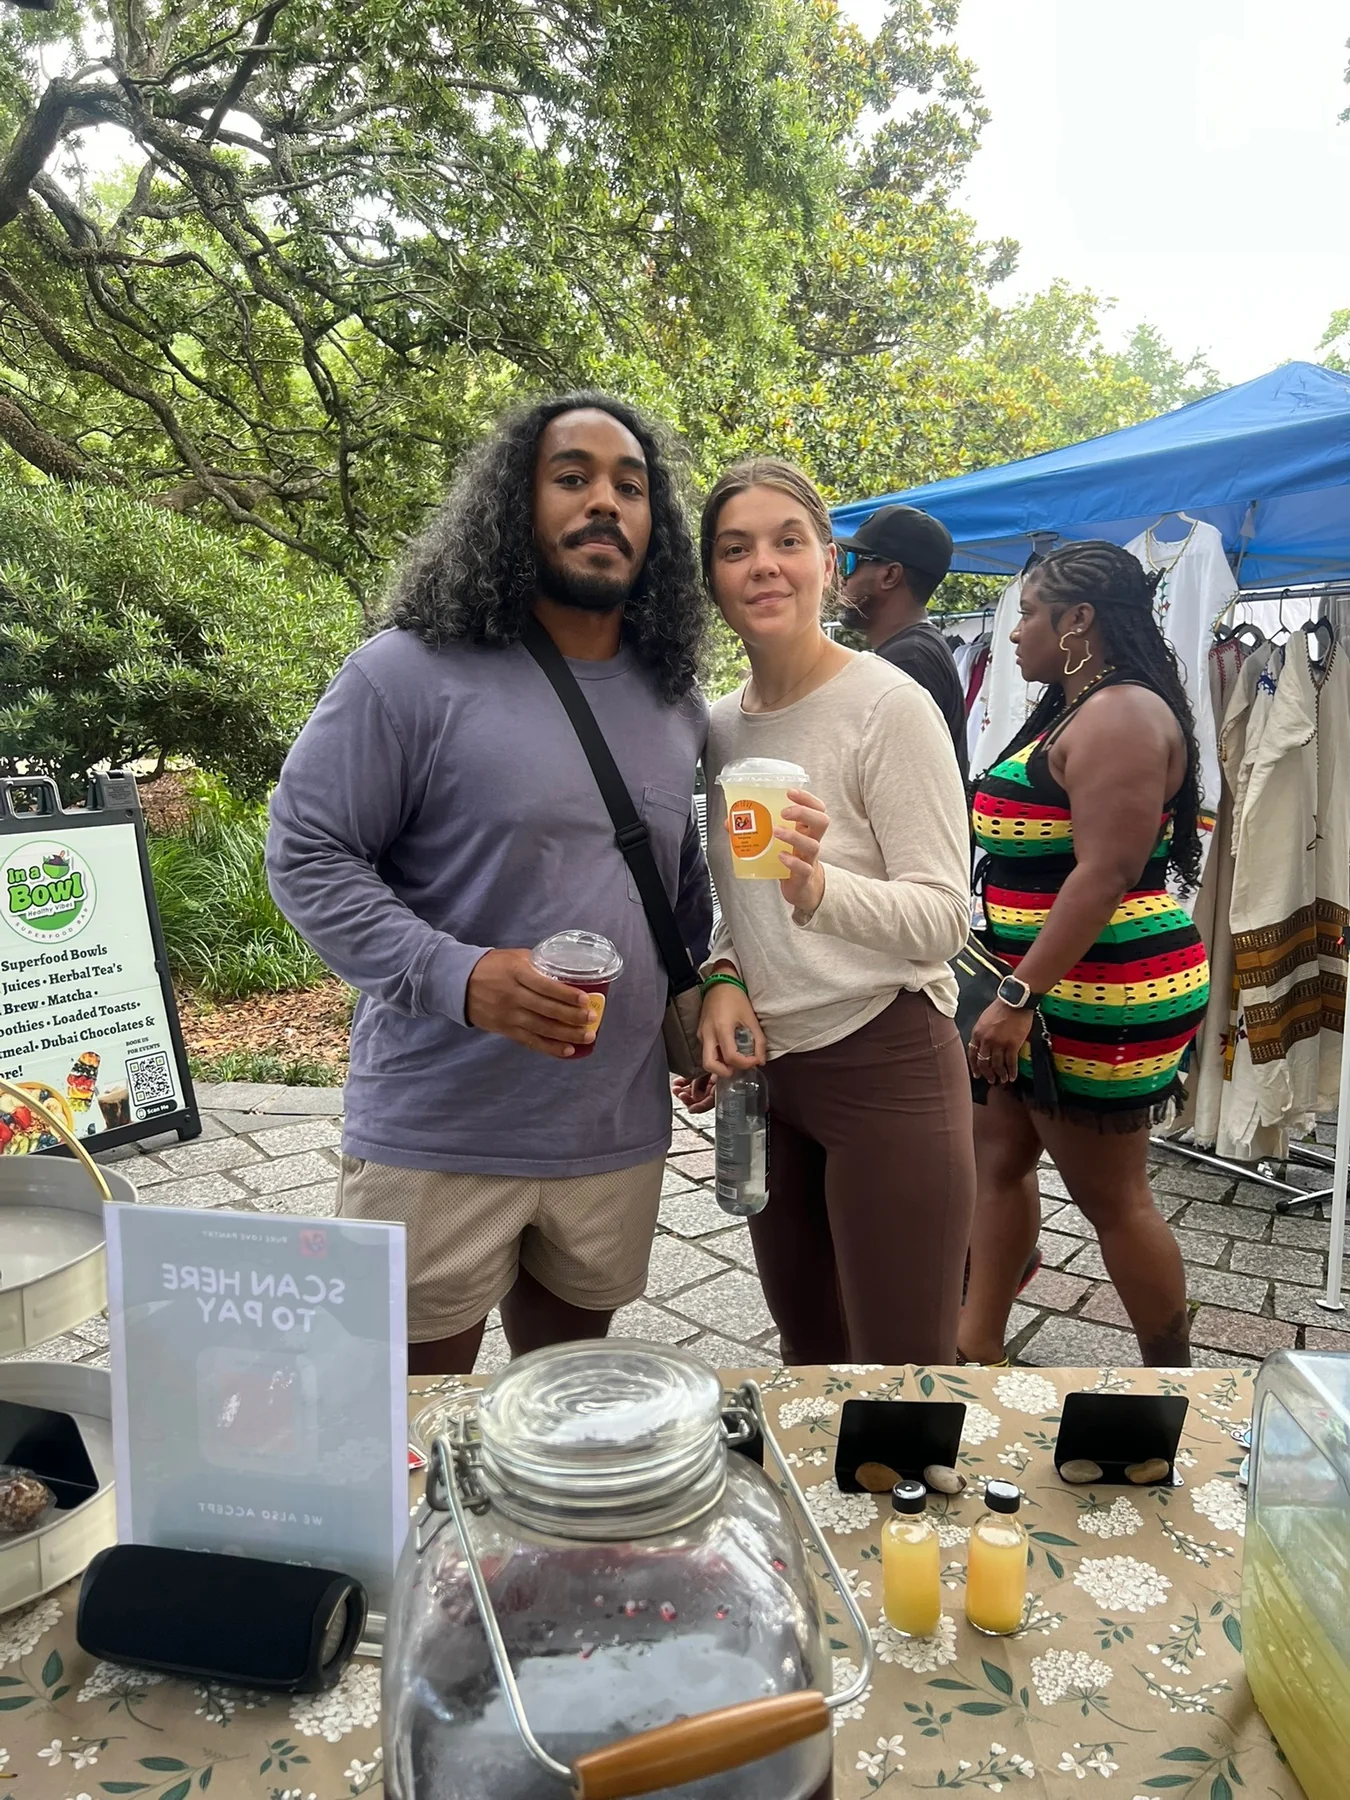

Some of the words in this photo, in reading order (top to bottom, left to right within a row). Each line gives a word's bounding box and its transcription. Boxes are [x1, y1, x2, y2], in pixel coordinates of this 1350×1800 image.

[7, 868, 27, 884] In
[29, 866, 41, 879] a
[7, 872, 84, 913] Bowl
[28, 902, 53, 916] Healthy
[55, 902, 73, 910] Vibes
[15, 922, 73, 939] SUPERFOOD
[1, 950, 68, 972] Superfood
[70, 944, 108, 960] Bowls
[2, 979, 40, 995] Juices
[48, 966, 91, 985] Herbal
[92, 963, 122, 977] Tea's
[3, 1000, 39, 1015] Brew
[47, 989, 92, 1006] Matcha
[52, 1004, 97, 1026] Loaded
[40, 1032, 78, 1050] Dubai
[80, 1018, 144, 1040] Chocolates
[146, 1016, 156, 1026] &
[126, 1038, 141, 1046] BOOK
[127, 1046, 138, 1055] FOR
[139, 1043, 160, 1053] EVENTS
[146, 1106, 160, 1114] Scan
